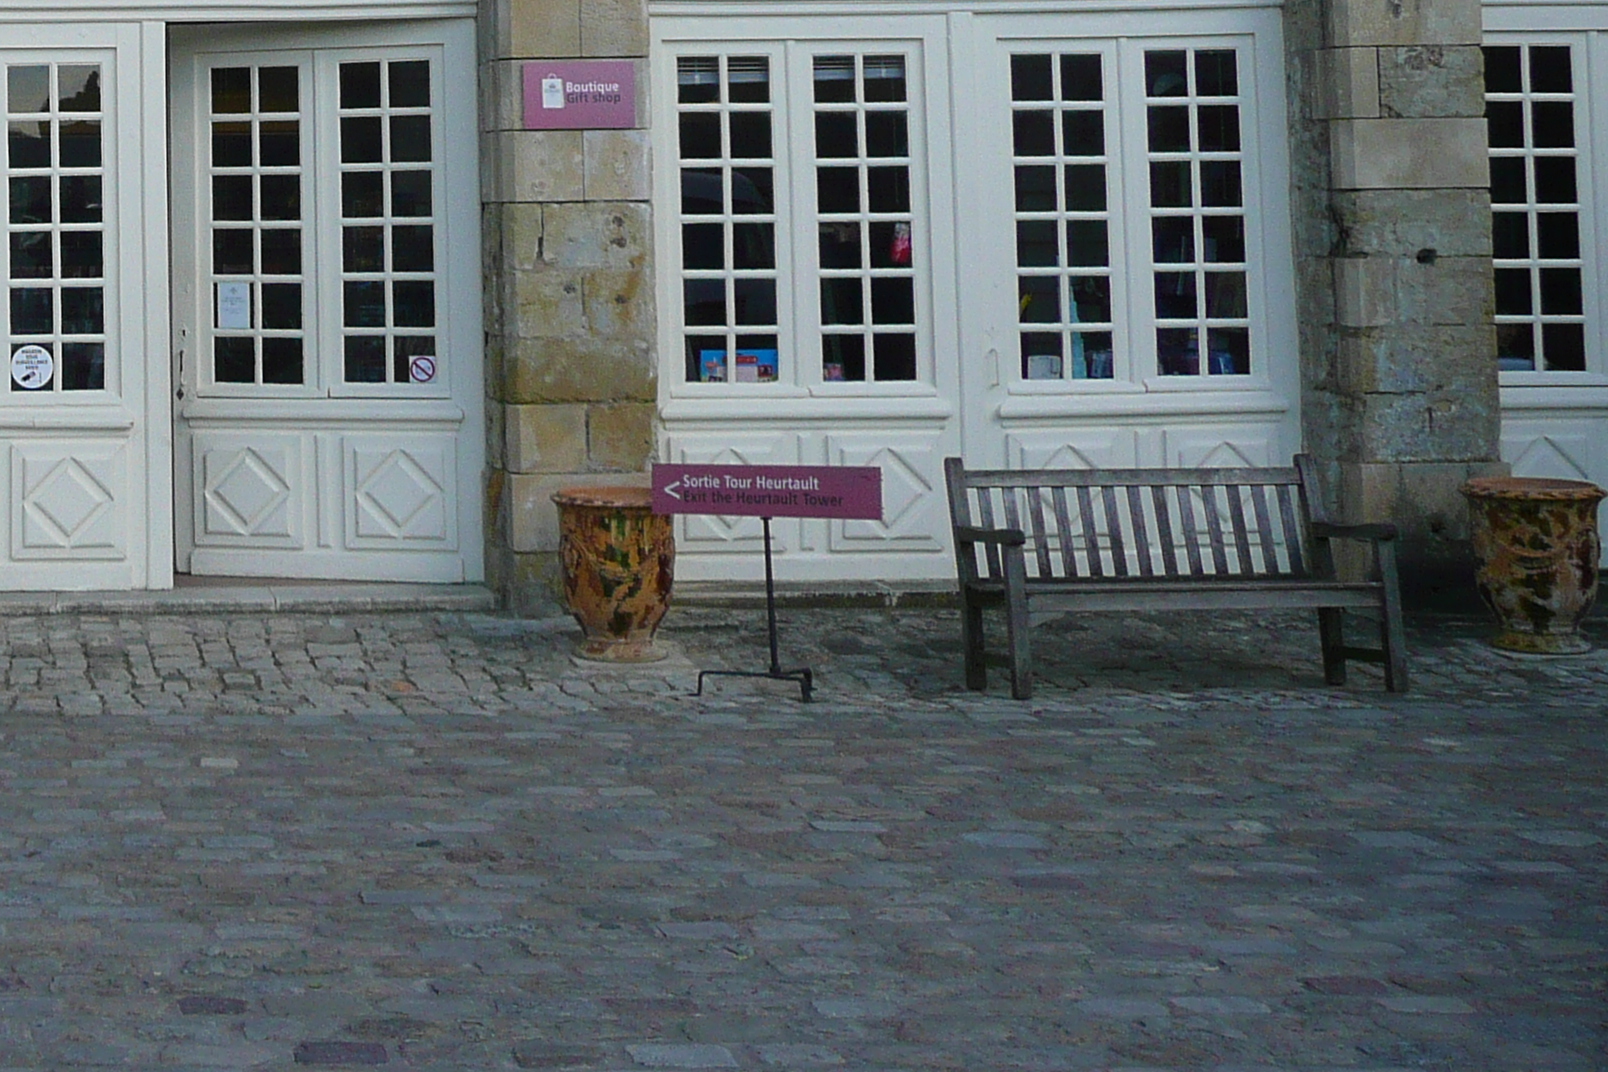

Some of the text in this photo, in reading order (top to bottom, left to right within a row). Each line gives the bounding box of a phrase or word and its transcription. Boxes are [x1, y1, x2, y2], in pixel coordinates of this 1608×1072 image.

[566, 81, 619, 94] Boutique
[567, 93, 621, 104] Gift shop
[683, 474, 819, 490] Sortie Tour Heurtault
[683, 490, 844, 506] Exit the Heurtault Tower
